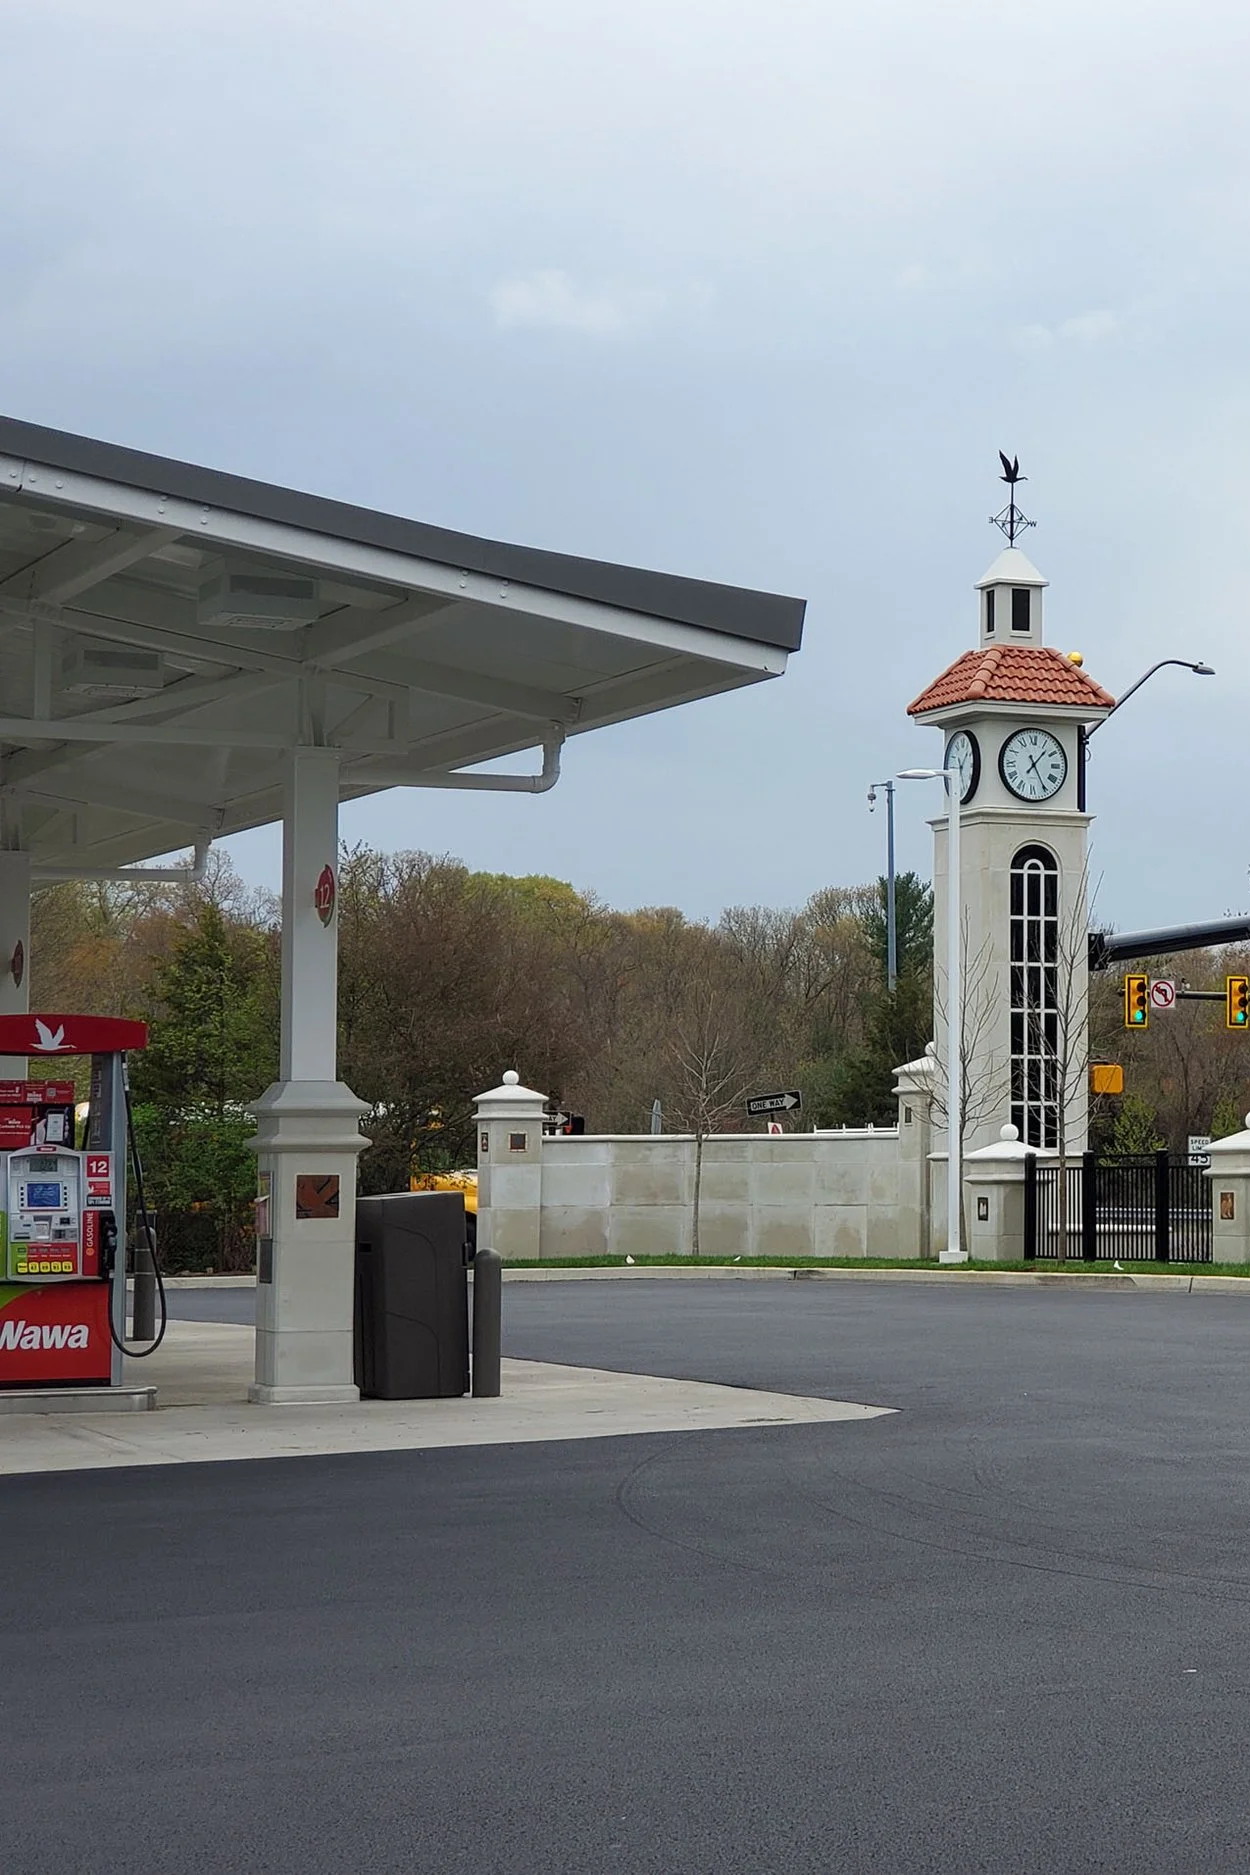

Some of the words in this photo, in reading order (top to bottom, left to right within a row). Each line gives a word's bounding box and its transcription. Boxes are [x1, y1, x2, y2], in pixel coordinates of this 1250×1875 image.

[319, 883, 330, 909] 12
[751, 1102, 768, 1110] ONE
[769, 1098, 784, 1107] WAY
[89, 1160, 108, 1174] 12
[1190, 1154, 1209, 1164] 45
[86, 1212, 94, 1248] GASOLINE
[0, 1320, 89, 1350] Wawa
